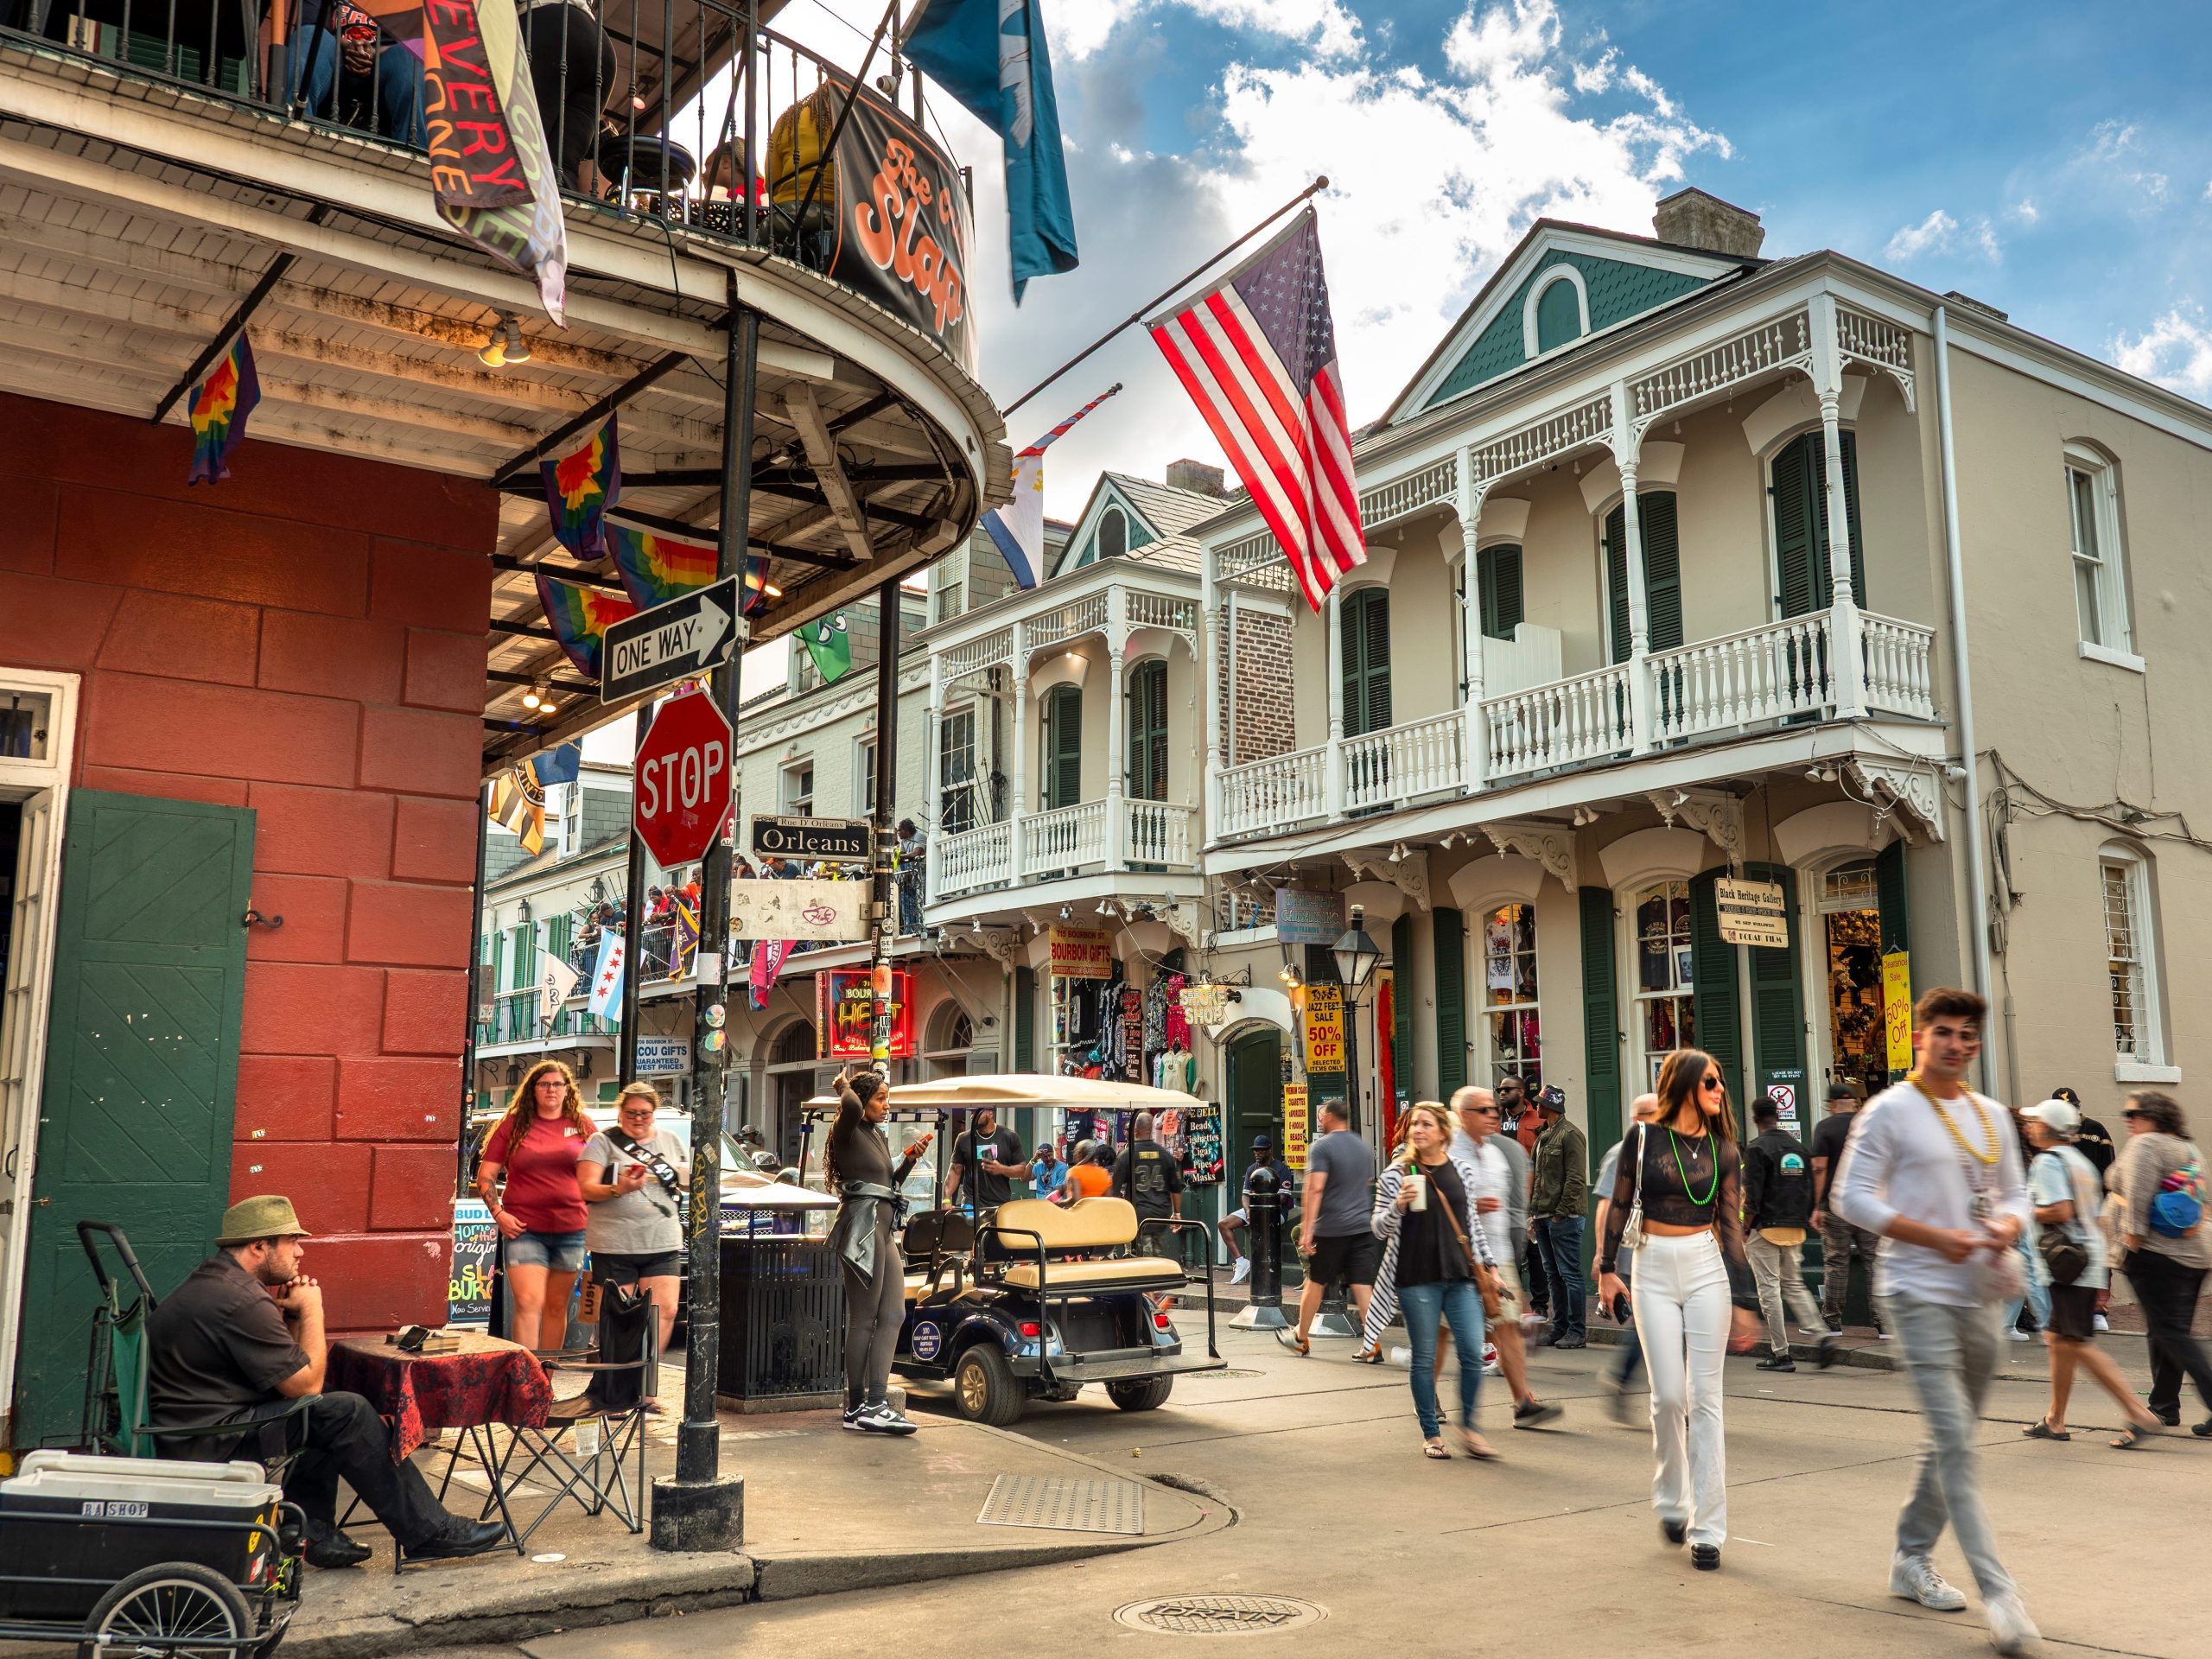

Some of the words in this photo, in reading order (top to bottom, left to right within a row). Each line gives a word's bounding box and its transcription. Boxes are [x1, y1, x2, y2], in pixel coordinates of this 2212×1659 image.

[424, 0, 524, 189] EVERY
[425, 72, 473, 194] ONE
[883, 138, 932, 205] The
[855, 173, 963, 336] Slap
[617, 636, 652, 674] ONE
[658, 619, 696, 659] WAY
[640, 741, 723, 818] STOP
[762, 829, 860, 853] Orleans
[1719, 888, 1735, 899] Black
[1738, 890, 1760, 905] Heritage
[1763, 893, 1782, 906] Gallery
[1068, 931, 1096, 939] BOURBON
[1052, 943, 1087, 961] BOURBON
[1090, 945, 1110, 962] GIFTS
[1890, 973, 1901, 982] Sale
[1179, 988, 1226, 1007] SMOKE
[1185, 1007, 1224, 1025] SHOP
[1307, 1003, 1322, 1012] JAZZ
[1325, 1002, 1339, 1011] FEST
[1886, 995, 1909, 1024] 50%
[839, 1002, 902, 1032] HET
[1315, 1013, 1333, 1022] SALE
[845, 1036, 867, 1046] GRILL
[890, 1031, 903, 1041] LUB
[1309, 1026, 1341, 1042] 50%
[1892, 1020, 1907, 1043] Off
[637, 1046, 658, 1056] COU
[661, 1046, 687, 1056] GIFTS
[1314, 1044, 1337, 1057] OFF
[1192, 1147, 1211, 1158] Cigar
[1193, 1160, 1212, 1170] Pipes
[1135, 1165, 1165, 1192] 34
[1192, 1173, 1216, 1182] Masks
[455, 1209, 482, 1219] BUD
[480, 1228, 496, 1242] the
[454, 1239, 497, 1266] origin
[585, 1281, 595, 1315] LUSH
[452, 1304, 465, 1315] Now
[467, 1303, 491, 1313] Servin
[109, 1504, 147, 1516] SHOP
[1154, 1606, 1287, 1624] DRAIN
